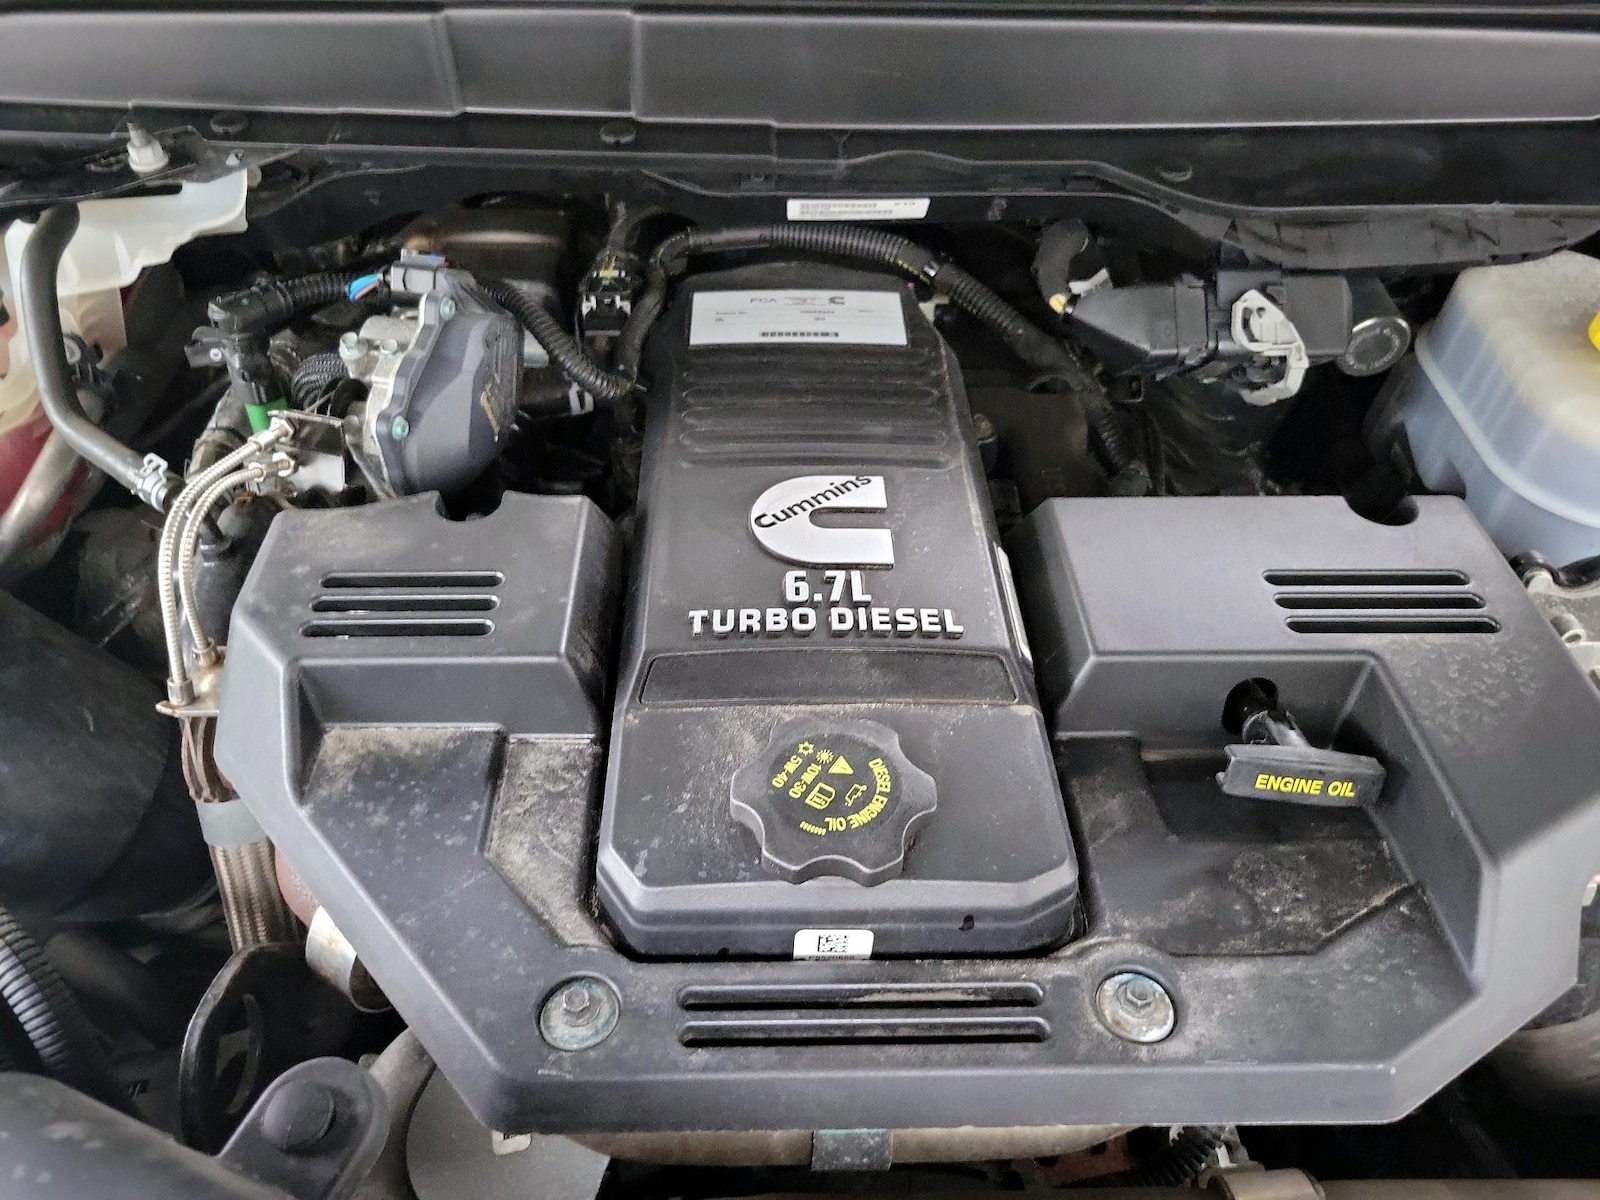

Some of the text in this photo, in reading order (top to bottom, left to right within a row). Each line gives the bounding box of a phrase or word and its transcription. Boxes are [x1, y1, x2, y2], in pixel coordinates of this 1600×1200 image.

[754, 475, 872, 529] Cummins
[783, 570, 872, 603] 6.7L
[688, 606, 966, 638] TURBO DIESEL
[772, 755, 803, 788] 5W-40
[789, 762, 822, 799] 10W-30
[1255, 774, 1355, 798] ENGINE OIL
[824, 758, 891, 832] DIESEL ENGINE OIL
